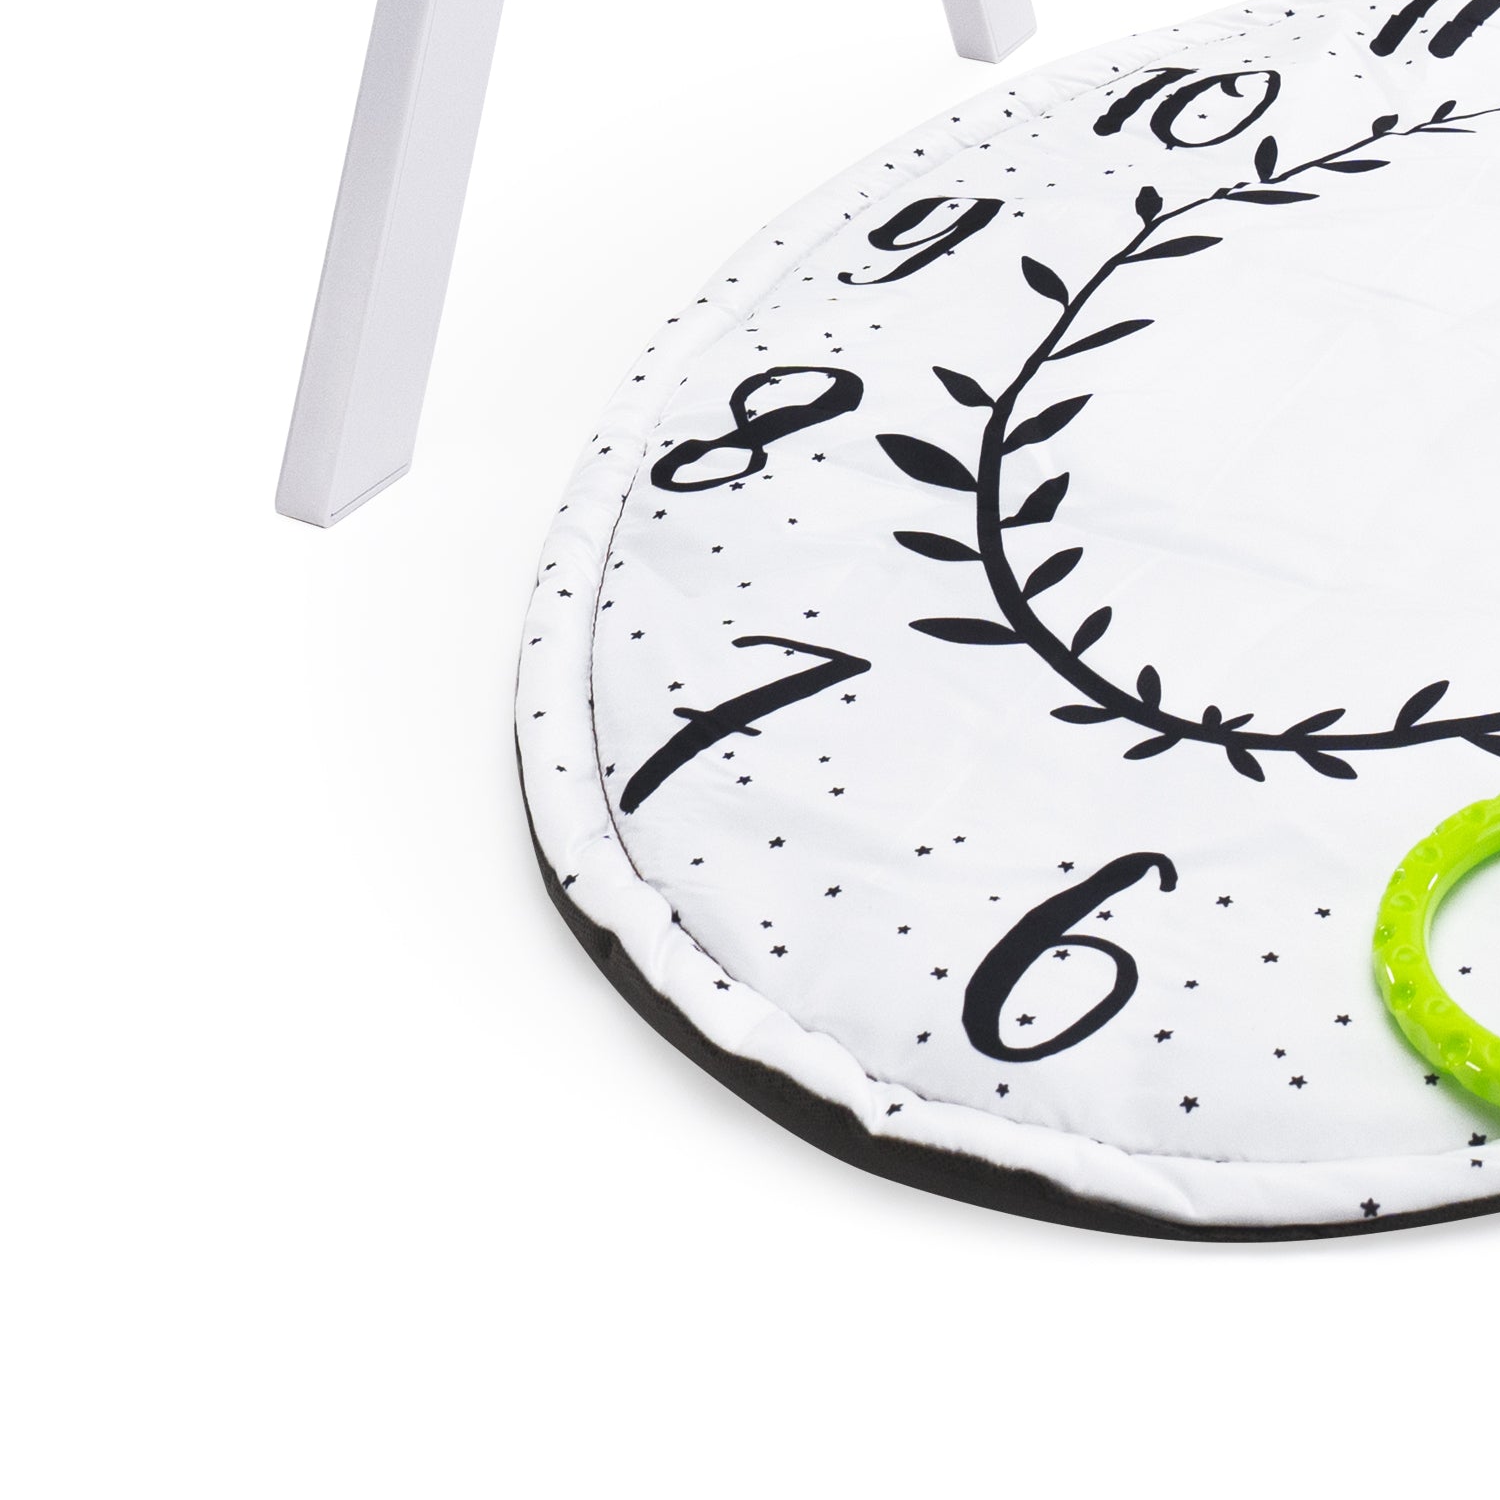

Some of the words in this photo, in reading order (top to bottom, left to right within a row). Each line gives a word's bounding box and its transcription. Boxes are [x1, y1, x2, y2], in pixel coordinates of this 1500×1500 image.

[1093, 66, 1281, 151] 10
[838, 196, 1005, 286] 9
[651, 366, 864, 493] 8
[620, 635, 872, 815] 7
[962, 852, 1177, 1063] 6
